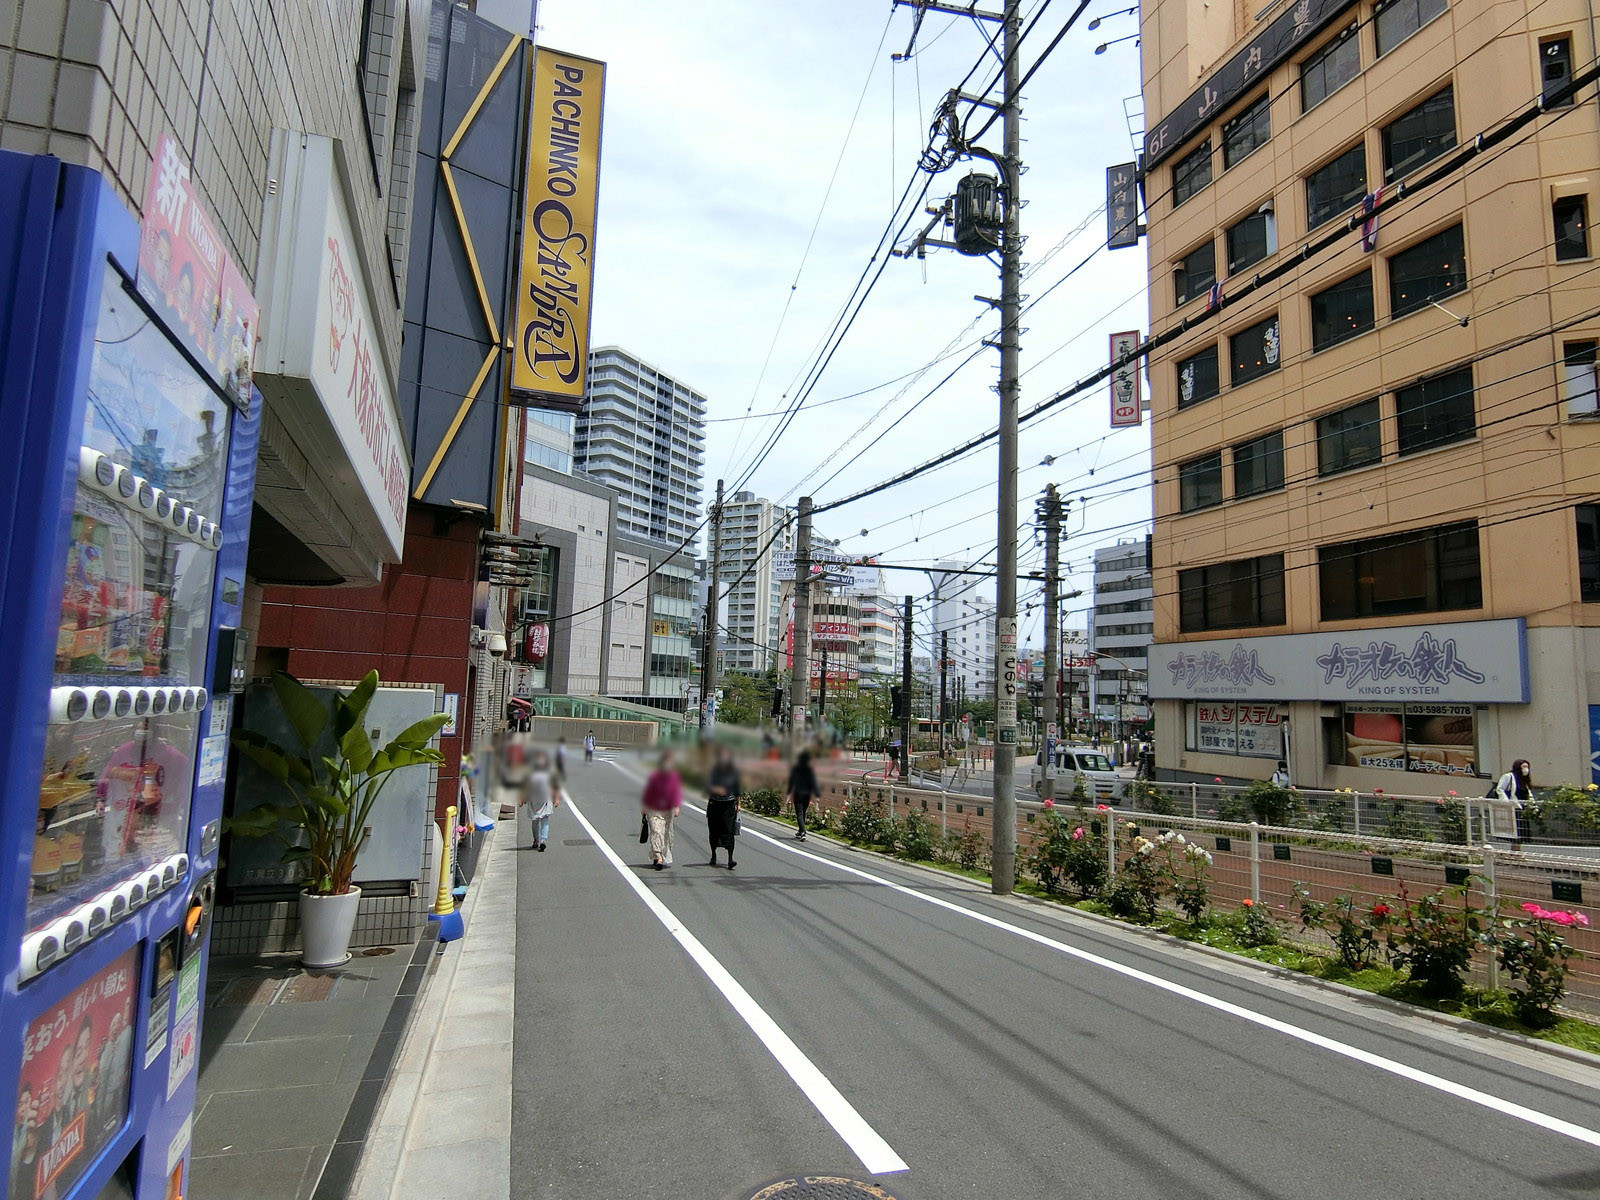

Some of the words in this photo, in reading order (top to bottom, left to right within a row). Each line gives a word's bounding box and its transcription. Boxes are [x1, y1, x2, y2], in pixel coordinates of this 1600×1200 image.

[547, 63, 584, 198] PACHINKO
[1150, 124, 1169, 156] 6F
[157, 138, 190, 237] 新
[1112, 171, 1132, 240] 山内農場
[191, 200, 217, 270] WONDA
[820, 624, 847, 632] アイフル
[1167, 644, 1275, 689] カラオケの鉄人
[1316, 631, 1485, 688] カラオケの鉄人
[518, 673, 526, 693] すみれ
[1004, 657, 1016, 695] さのや
[1359, 687, 1381, 695] KING
[1383, 687, 1396, 695] OF
[1399, 687, 1439, 695] SYSTEM
[1199, 704, 1280, 726] 鉄人システム
[1413, 705, 1471, 715] 03-5985-7078
[1201, 735, 1255, 750] 1部屋で歌える
[1359, 757, 1404, 769] 最大25名様
